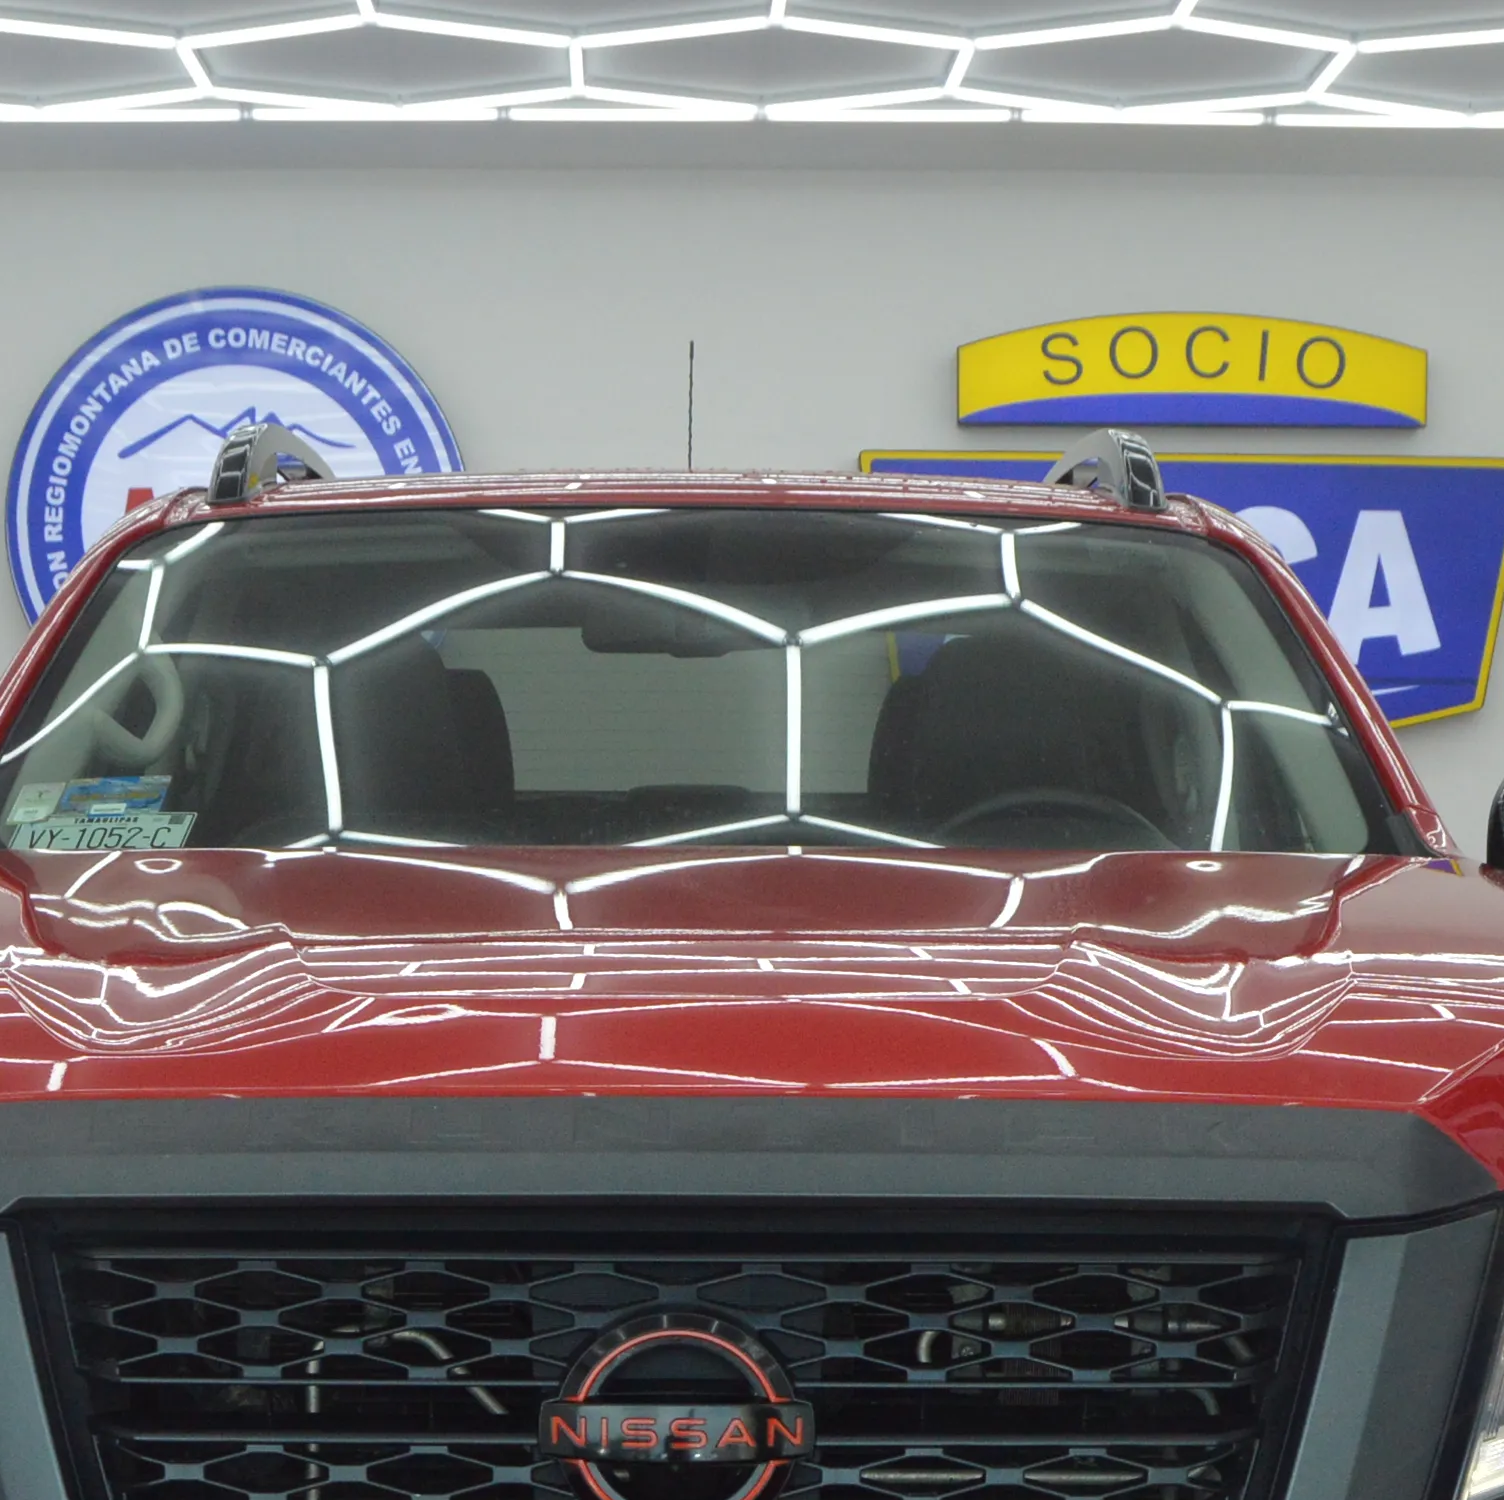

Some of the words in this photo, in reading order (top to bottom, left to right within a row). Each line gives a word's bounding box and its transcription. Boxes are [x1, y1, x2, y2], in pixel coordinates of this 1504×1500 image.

[162, 331, 202, 361] DE
[1040, 325, 1347, 389] SOCIO
[207, 327, 402, 438] COMERCIANTES
[43, 349, 162, 543] REGIOMONTANA
[392, 437, 423, 476] EN
[46, 550, 69, 591] ON
[27, 825, 172, 850] VY-1052-C
[73, 816, 140, 824] TAMAULIPAS
[549, 1415, 804, 1448] NISSAN
